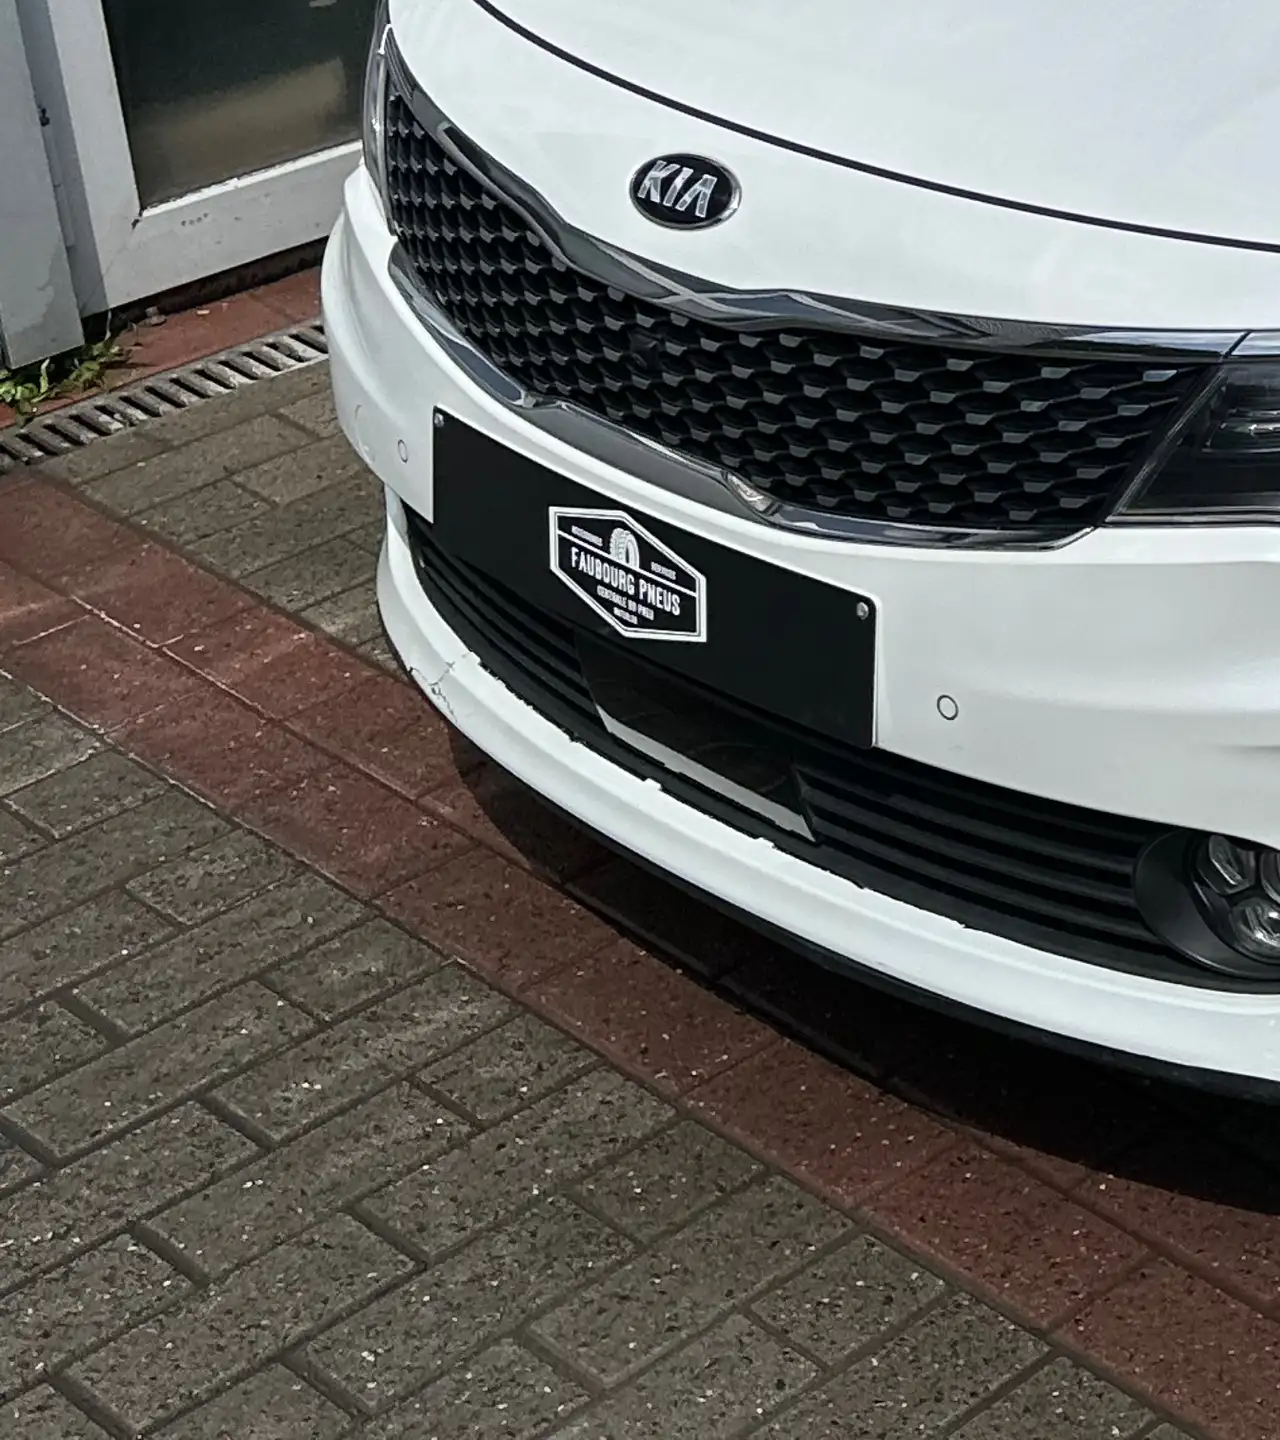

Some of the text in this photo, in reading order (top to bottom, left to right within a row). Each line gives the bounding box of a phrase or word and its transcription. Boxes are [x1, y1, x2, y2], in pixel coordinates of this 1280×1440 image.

[637, 160, 718, 218] KIA
[571, 547, 636, 596] FAUBOURG
[639, 579, 681, 616] PNEUS
